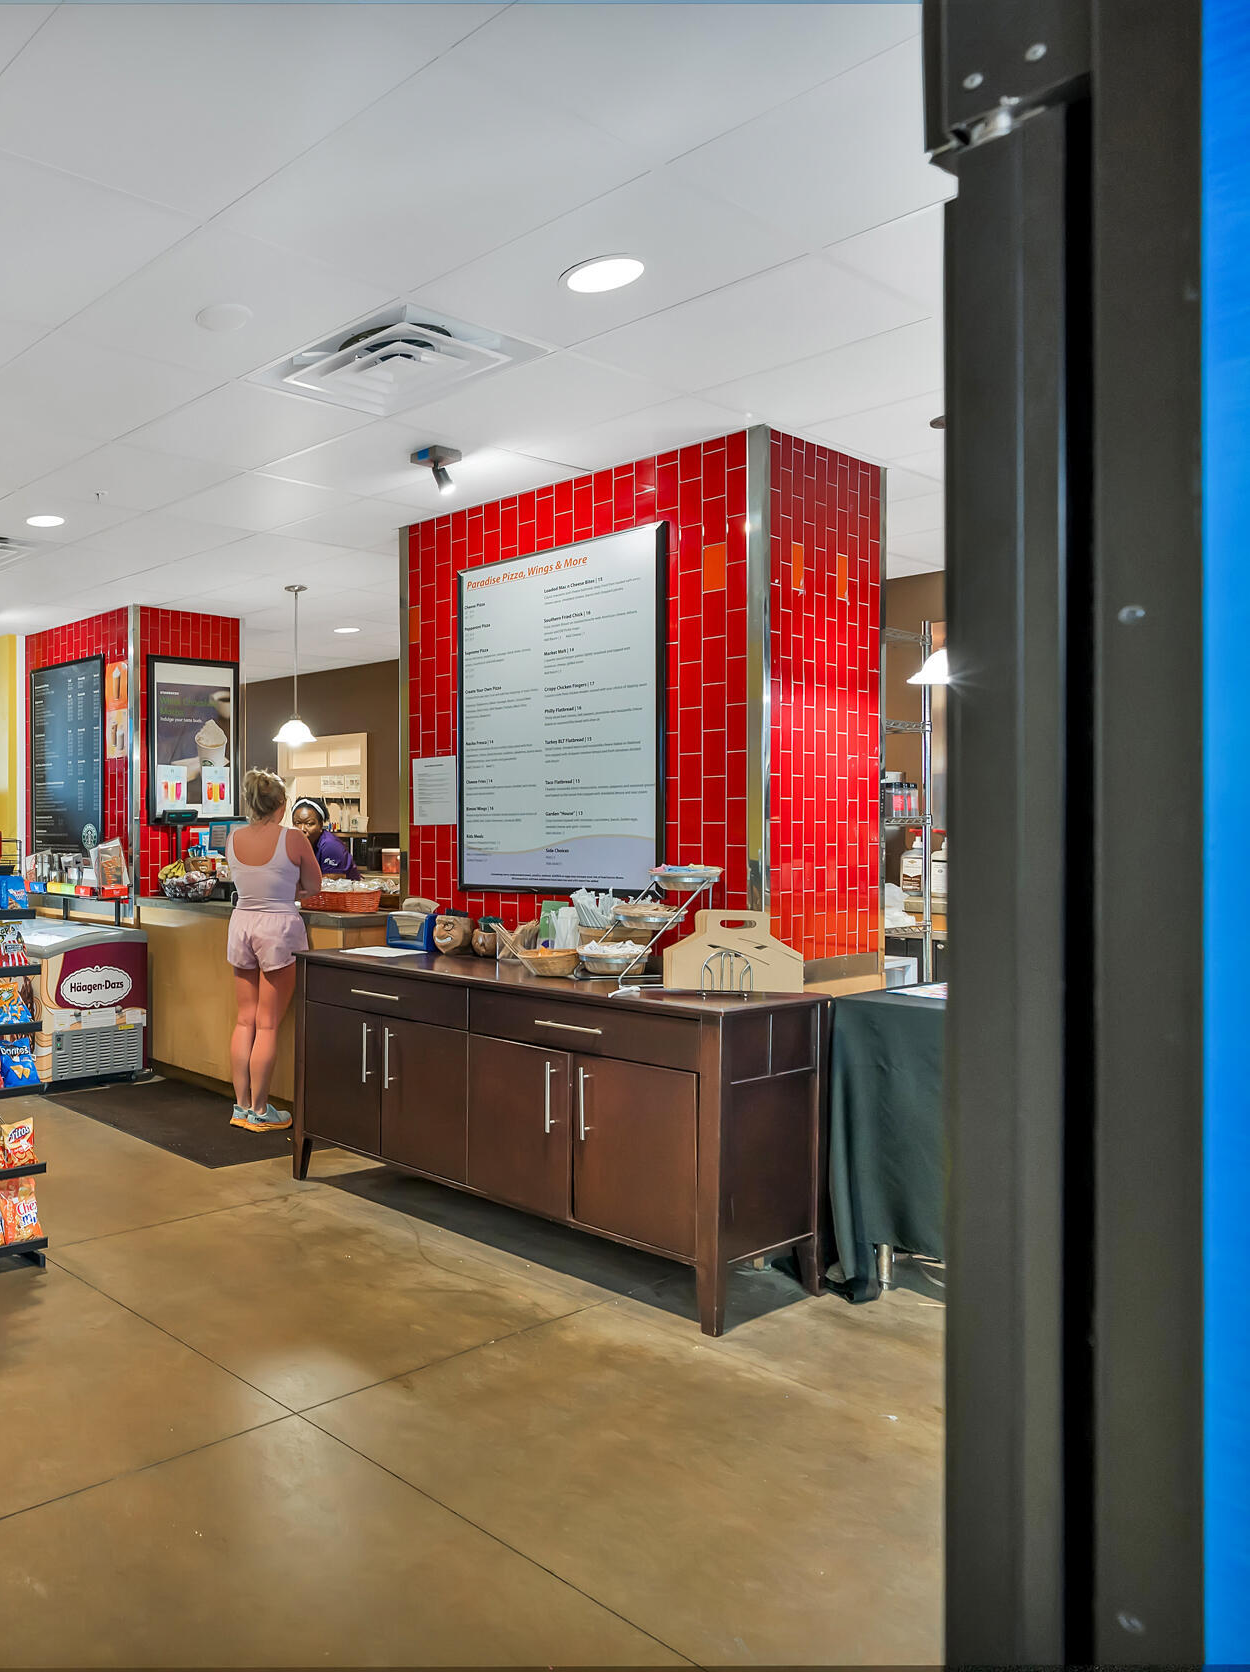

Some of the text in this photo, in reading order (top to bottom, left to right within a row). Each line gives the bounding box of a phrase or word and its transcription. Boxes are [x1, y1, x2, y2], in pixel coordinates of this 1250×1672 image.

[467, 555, 588, 590] Paradise Pizza, Wings & More
[70, 980, 124, 993] Häagen-Dazs
[0, 1046, 30, 1056] Doritos
